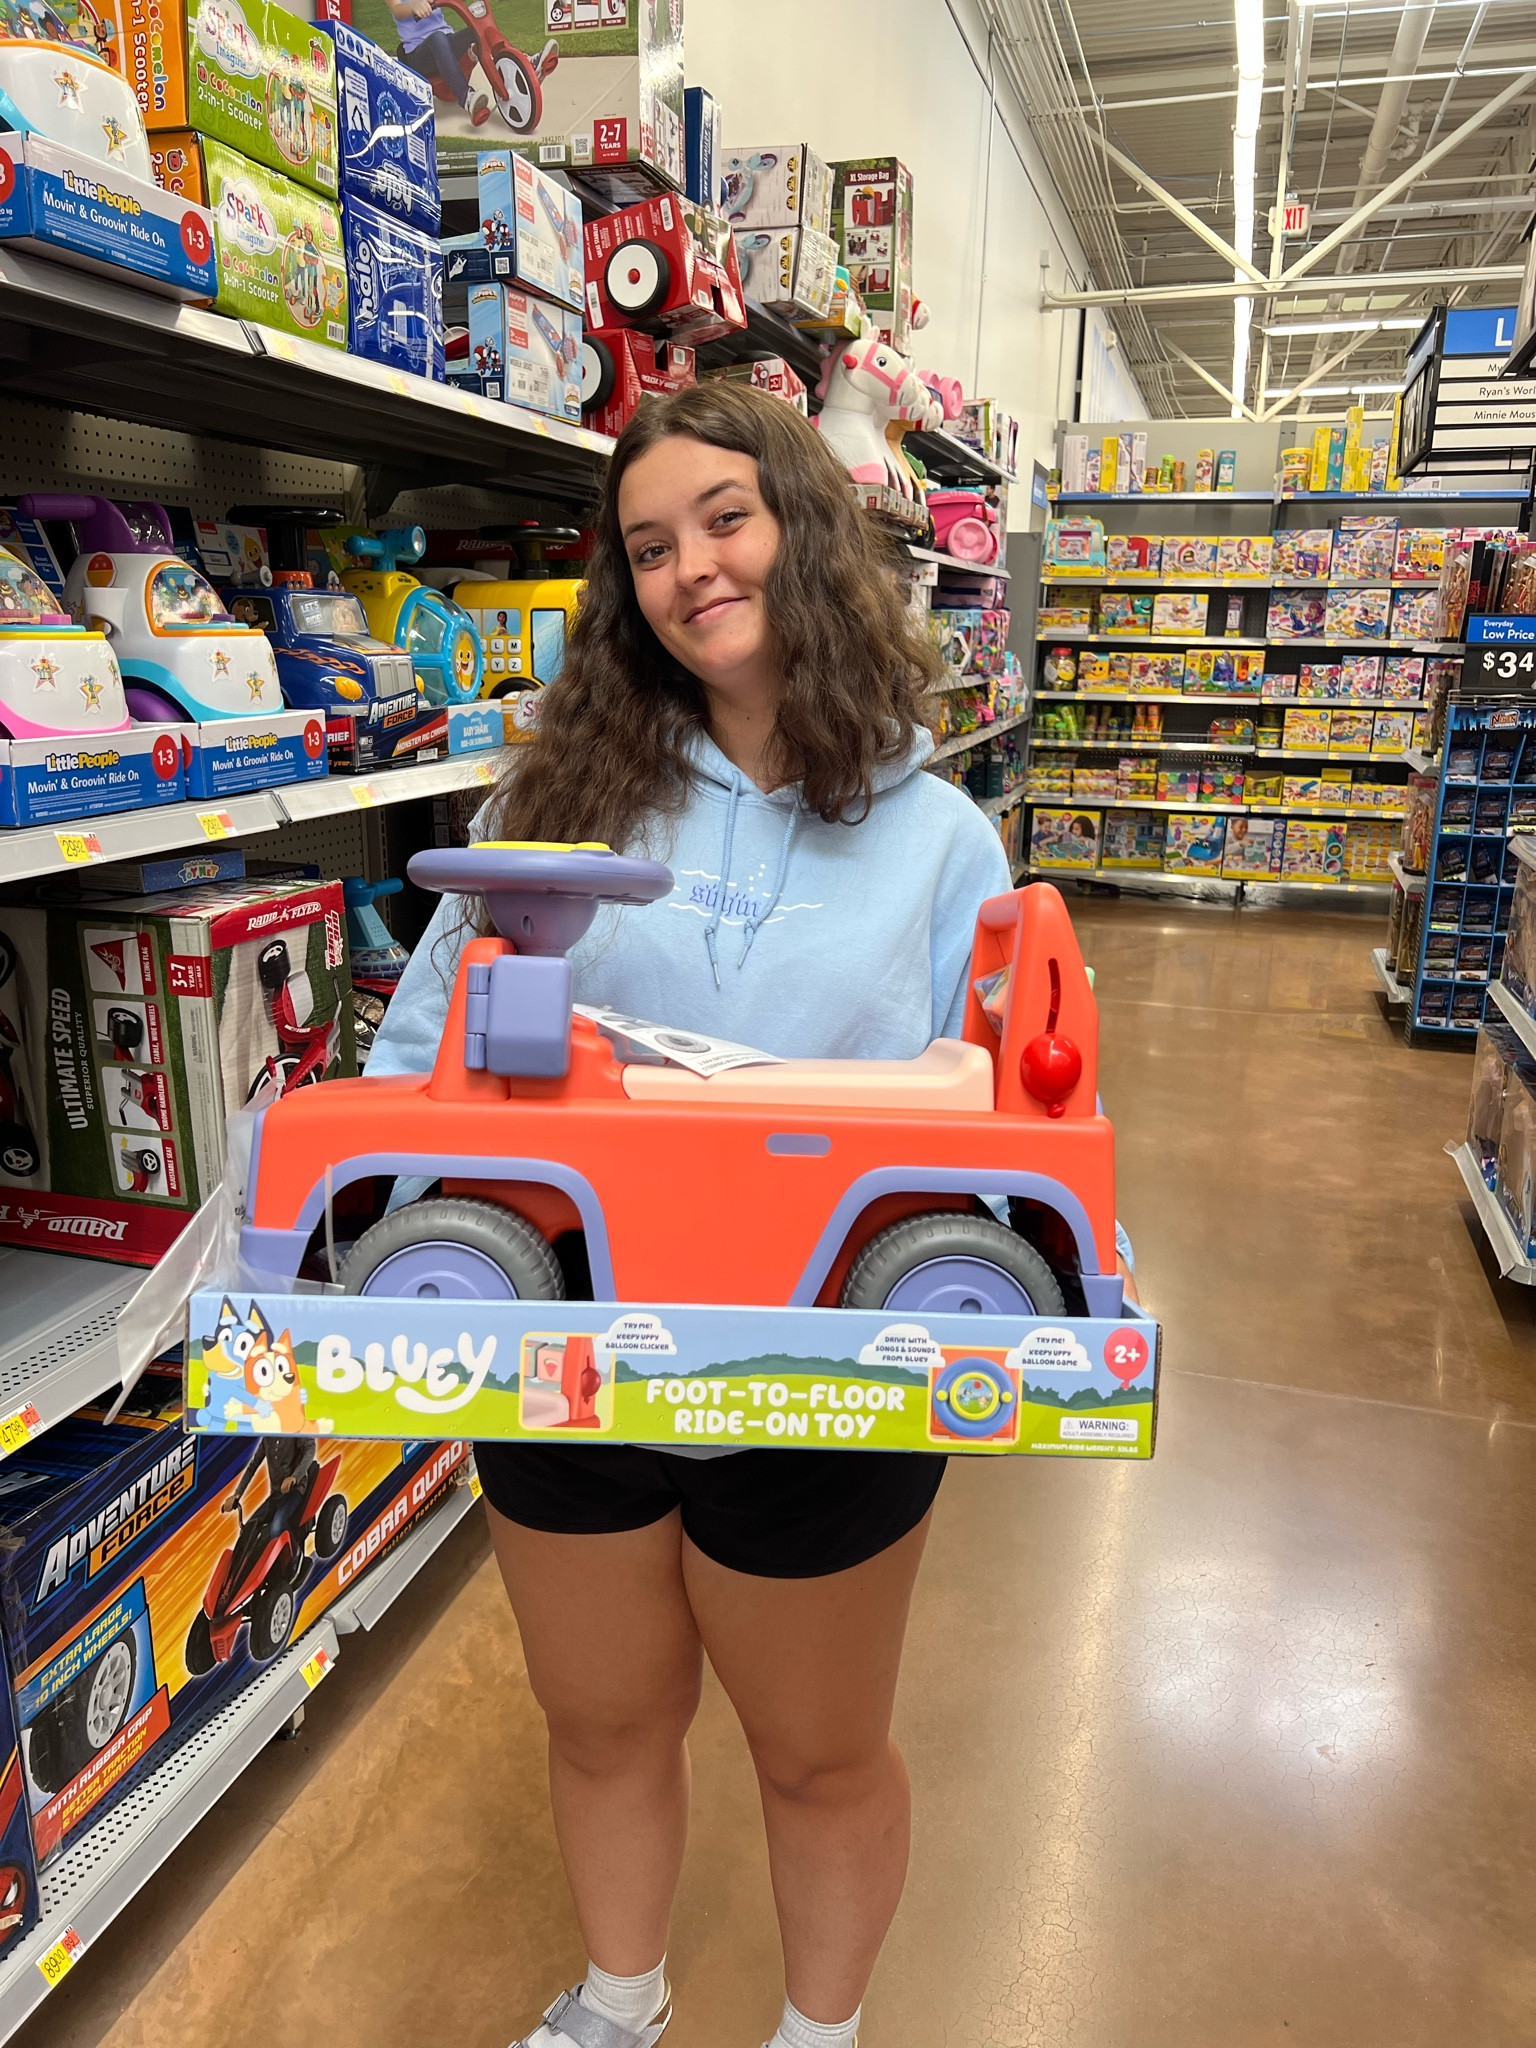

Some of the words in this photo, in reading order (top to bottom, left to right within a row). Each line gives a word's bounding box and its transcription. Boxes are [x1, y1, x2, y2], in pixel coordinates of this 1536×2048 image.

[204, 5, 254, 61] Spark
[215, 41, 247, 70] Imagine
[133, 31, 149, 114] Scooter
[197, 88, 225, 112] 2-in-1
[227, 102, 263, 132] Scooter
[600, 123, 621, 142] 2-7
[599, 142, 621, 150] YEARS
[849, 173, 857, 182] XL
[857, 172, 878, 182] Storage
[878, 171, 889, 182] Bag
[43, 190, 77, 214] Movin'
[79, 205, 88, 219] &
[89, 208, 129, 235] Groovin'
[130, 222, 150, 242] Ride
[152, 231, 166, 248] On
[226, 192, 270, 237] Spark
[186, 227, 205, 250] 1-3
[236, 226, 265, 248] Imagine
[223, 272, 246, 292] 2-in-1
[248, 281, 279, 304] Scooter
[356, 237, 376, 322] halo
[1479, 386, 1510, 398] Ryan's
[1474, 410, 1507, 420] Minnie
[300, 600, 320, 614] LET'S
[1483, 620, 1514, 628] Everyday
[1483, 629, 1505, 640] Low
[1507, 629, 1535, 640] Price
[368, 692, 417, 725] ADVENTURE
[307, 731, 320, 747] 1-3
[157, 748, 174, 766] 1-3
[212, 759, 235, 772] Movin'
[235, 758, 242, 768] &
[243, 753, 269, 767] Groovin'
[270, 751, 284, 762] Ride
[285, 749, 294, 760] On
[27, 778, 58, 795] Movin'
[60, 780, 69, 790] &
[70, 773, 107, 789] Groovin'
[109, 772, 126, 783] Ride
[128, 770, 140, 781] On
[246, 912, 279, 932] RADIO
[290, 902, 322, 919] FLYER
[144, 961, 152, 983] RACING
[172, 962, 187, 988] 3-7
[51, 987, 72, 1043] SPEED
[147, 1005, 157, 1027] WHEELS
[74, 1011, 88, 1057] QUALITY
[150, 1027, 158, 1041] WIDE
[152, 1042, 161, 1064] STABLE,
[54, 1047, 89, 1130] ULTIMATE
[80, 1060, 94, 1110] SUPERIOR
[156, 1074, 168, 1109] HANDLEBARS
[159, 1109, 169, 1131] CHROME
[164, 1146, 174, 1159] SEAT
[166, 1160, 177, 1190] ADJUSTABLE
[47, 1216, 129, 1241] RADIO
[884, 1336, 906, 1344] DRIVE
[907, 1346, 936, 1354] SOUNDS
[1036, 1336, 1050, 1344] TRY
[1050, 1336, 1065, 1344] ME!
[882, 1354, 903, 1362] FROM
[904, 1355, 928, 1363] BLUEY
[1114, 1344, 1141, 1364] 2+
[316, 1331, 496, 1414] BLUEY
[647, 1379, 905, 1412] FOOT-TO-FLOOR
[674, 1409, 809, 1437] RIDE-ON
[814, 1413, 877, 1440] TOY
[1079, 1420, 1129, 1431] WARNING:
[337, 1495, 409, 1587] COBRA
[412, 1440, 464, 1506] QUAD
[414, 1482, 447, 1521] Powered
[36, 1434, 197, 1604] ADVENTURE
[40, 1641, 82, 1689] EXTRA
[84, 1603, 123, 1646] LARGE
[51, 1659, 81, 1693] INCH
[83, 1608, 133, 1663] WHEELS!
[47, 1783, 77, 1820] WITH
[79, 1734, 126, 1789] RUBBER
[127, 1706, 153, 1739] GRIP
[62, 1775, 100, 1820] BETTER
[101, 1726, 147, 1778] TRACTION
[62, 1818, 71, 1830] &
[72, 1741, 143, 1820] ACCELERATION
